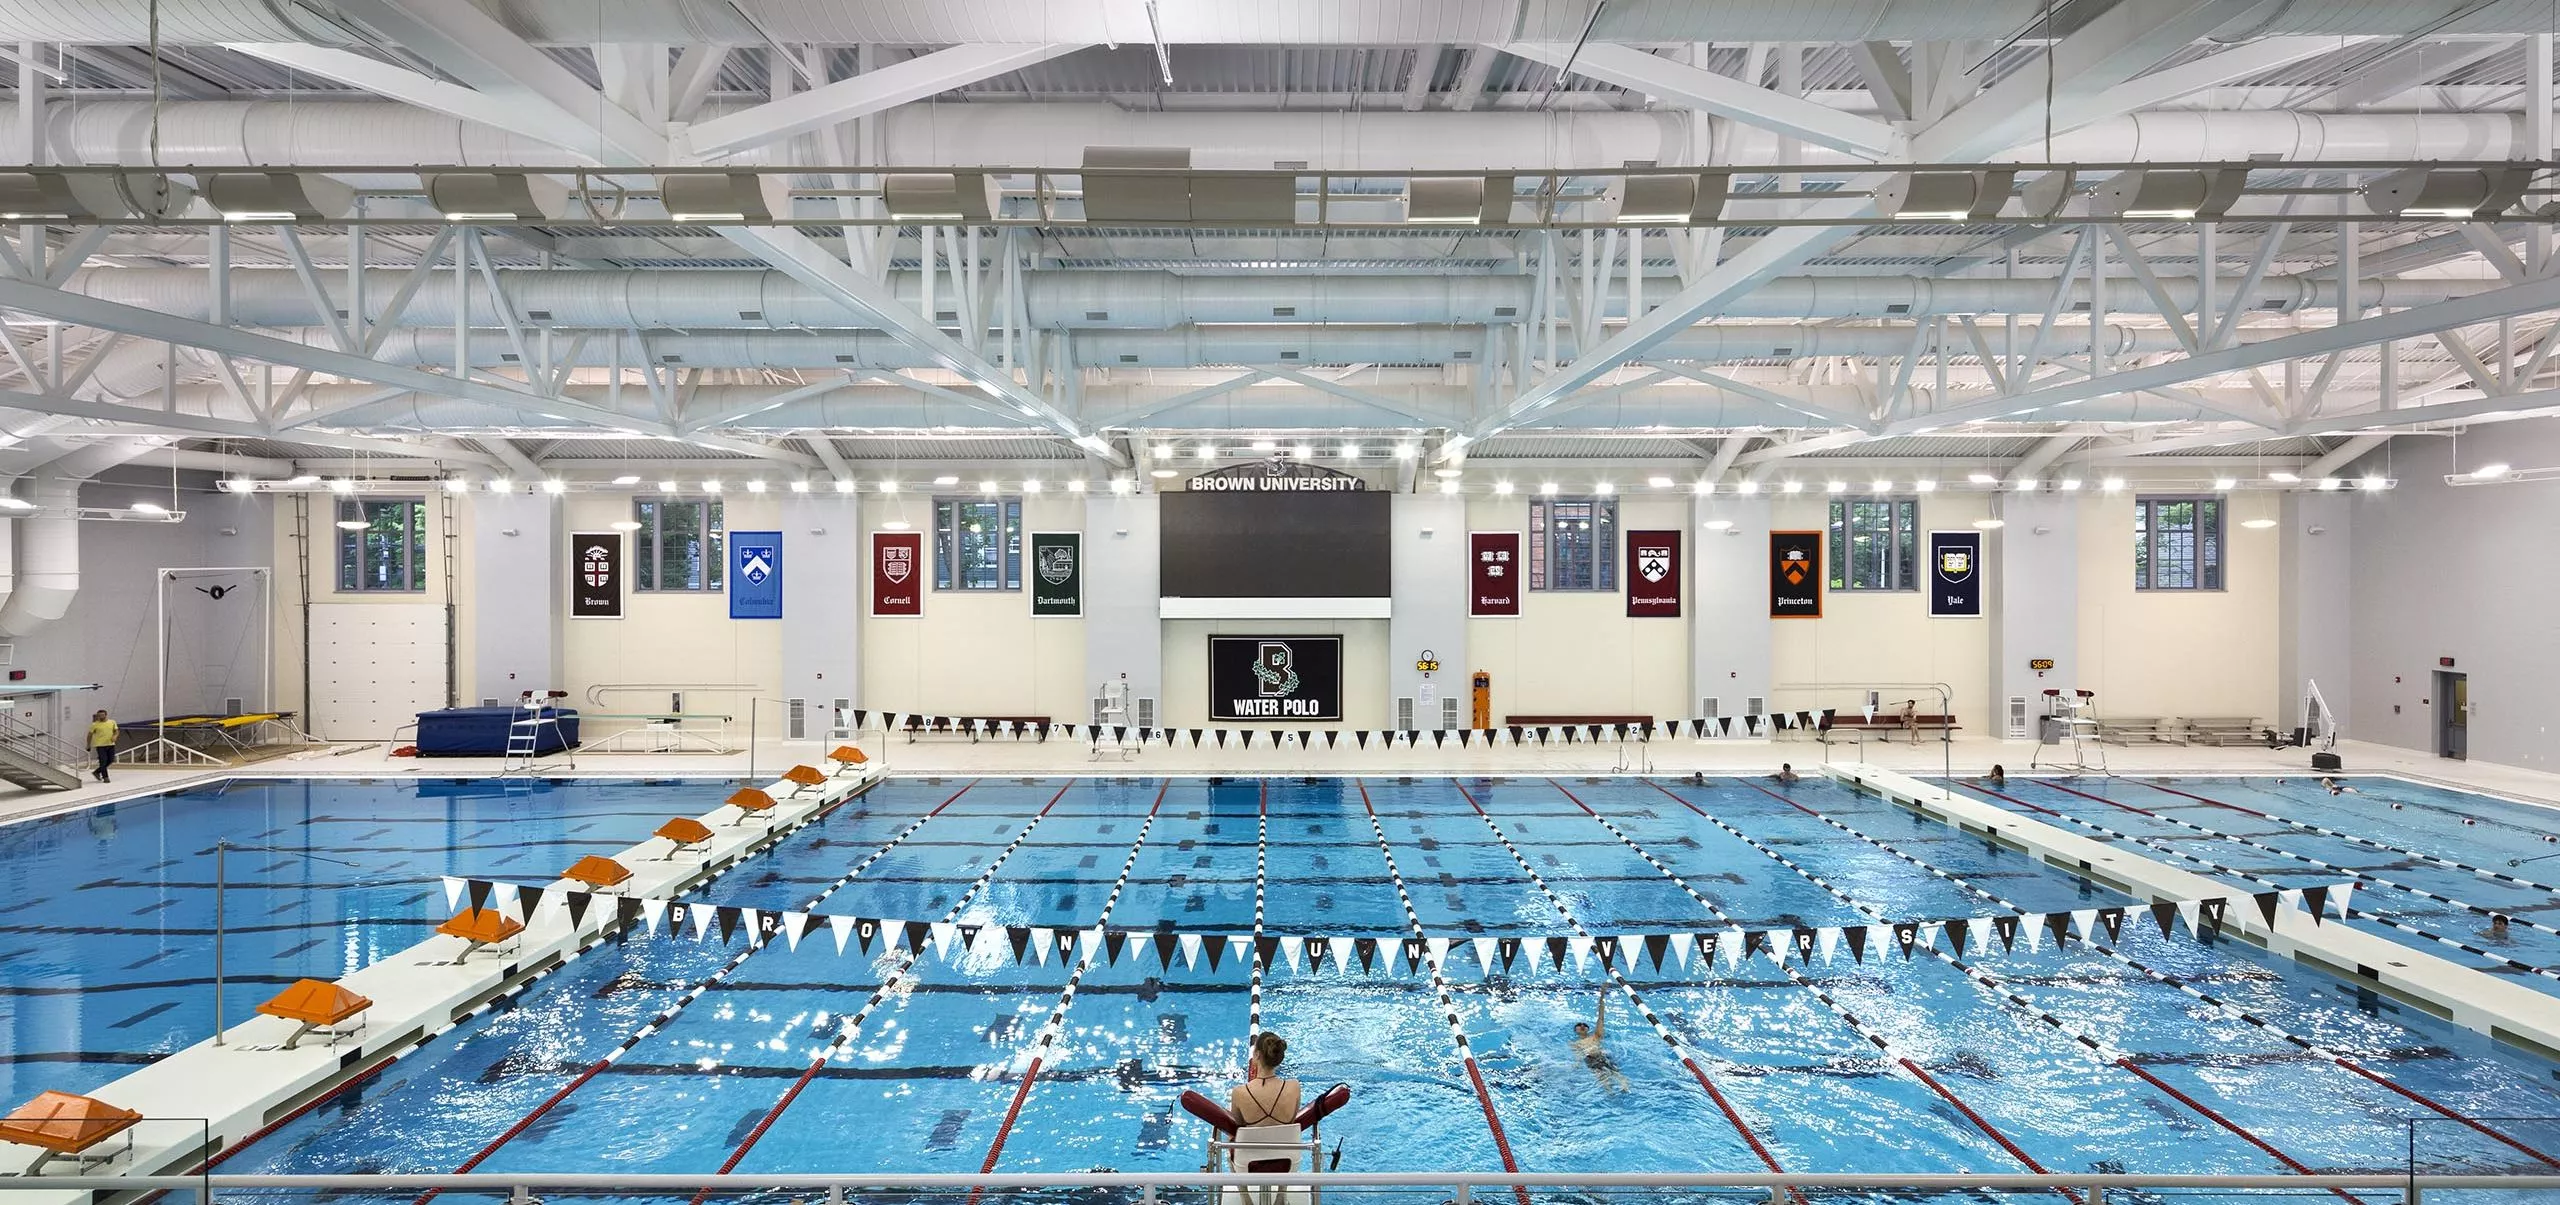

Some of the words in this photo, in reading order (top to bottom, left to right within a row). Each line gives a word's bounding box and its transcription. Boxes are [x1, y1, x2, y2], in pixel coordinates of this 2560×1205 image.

[1192, 477, 1255, 491] BROWN
[1260, 477, 1358, 491] UNIVERSITY
[584, 597, 610, 606] Brown
[883, 596, 911, 605] Cornell
[1037, 596, 1076, 607] Dartmouth
[1481, 596, 1510, 606] Harvard
[1632, 596, 1677, 606] Pennsylvania
[1777, 596, 1813, 607] Princeton
[1947, 595, 1964, 606] Yale
[1233, 699, 1279, 716] WATER
[1283, 699, 1319, 716] POLO
[925, 719, 932, 727] 8
[1762, 718, 1766, 726] 1
[1053, 724, 1060, 733] 7
[1631, 726, 1638, 735] 2
[1155, 731, 1161, 739] 6
[1287, 734, 1294, 742] 5
[1398, 733, 1404, 741] 4
[1527, 730, 1533, 738] 3
